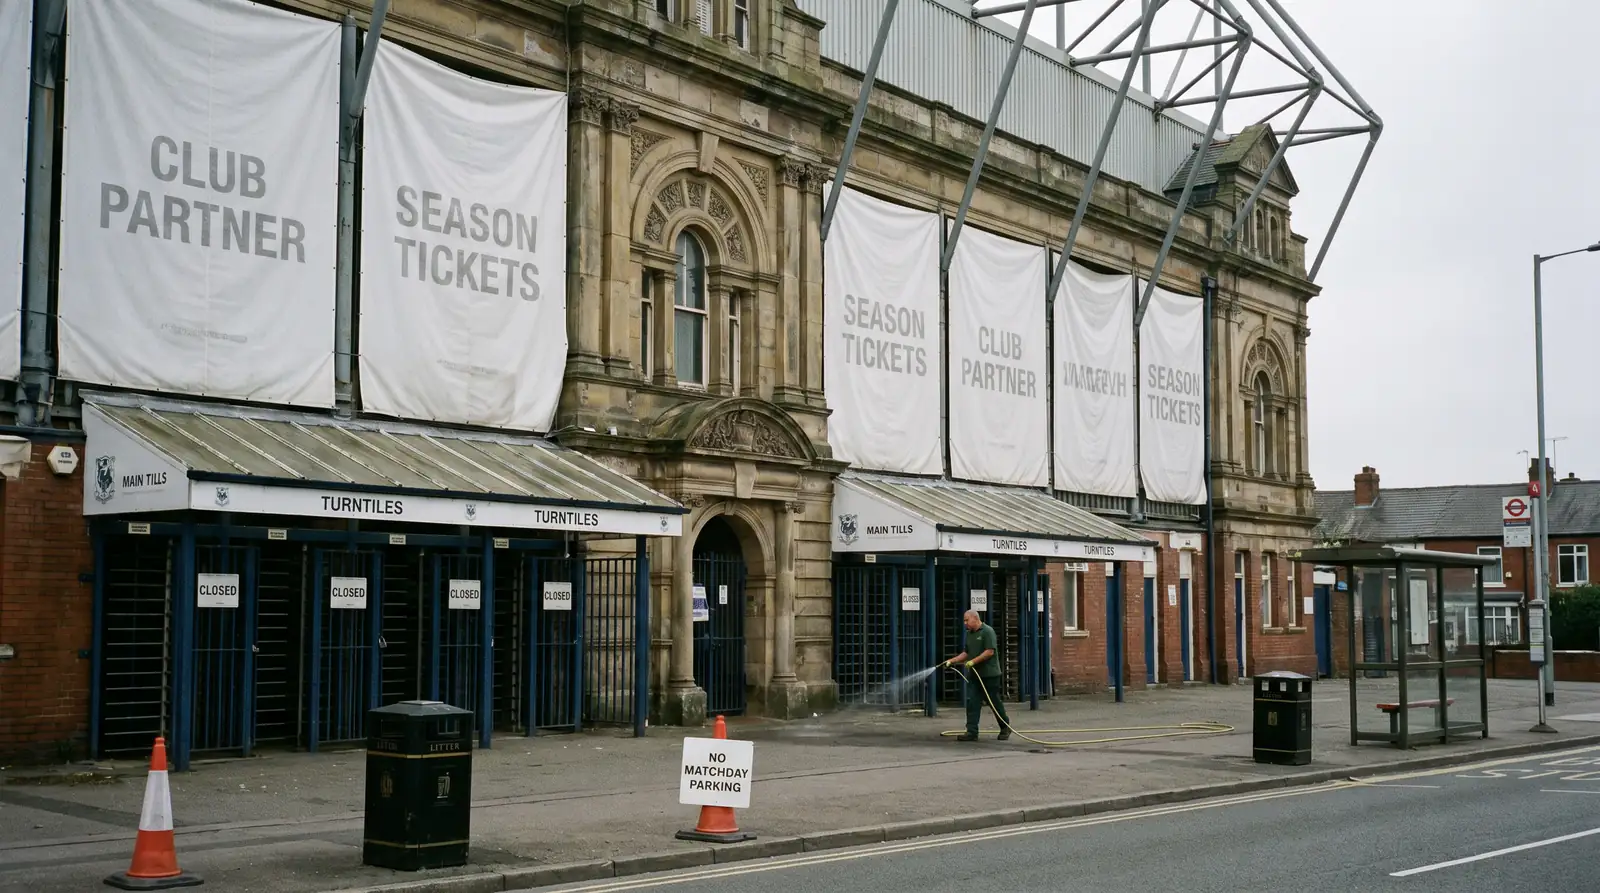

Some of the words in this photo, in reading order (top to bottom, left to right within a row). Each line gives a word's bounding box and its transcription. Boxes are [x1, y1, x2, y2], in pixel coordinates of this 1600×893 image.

[150, 135, 266, 199] CLUB
[100, 182, 306, 263] PARTNER
[396, 185, 538, 253] SEASON
[394, 236, 540, 302] TICKETS
[843, 294, 925, 339] SEASON
[979, 326, 1022, 360] CLUB
[842, 333, 927, 377] TICKETS
[961, 356, 1037, 398] PARTNER
[1147, 364, 1200, 397] SEASON
[1147, 394, 1201, 426] TICKETS
[122, 474, 144, 489] MAIN
[146, 472, 167, 486] TILLS
[321, 495, 404, 515] TURNTILES
[534, 509, 599, 527] TURNTILES
[866, 526, 889, 535] MAIN
[890, 524, 914, 534] TILLS
[992, 539, 1028, 551] TURNTILES
[1083, 545, 1115, 556] TURNTILES
[199, 585, 237, 596] CLOSED
[332, 587, 365, 598] CLOSED
[450, 589, 480, 599] CLOSED
[544, 591, 571, 601] CLOSED
[430, 742, 460, 752] LITTER
[708, 752, 726, 763] NO
[684, 765, 748, 778] MATCHDAY
[689, 780, 741, 792] PARKING
